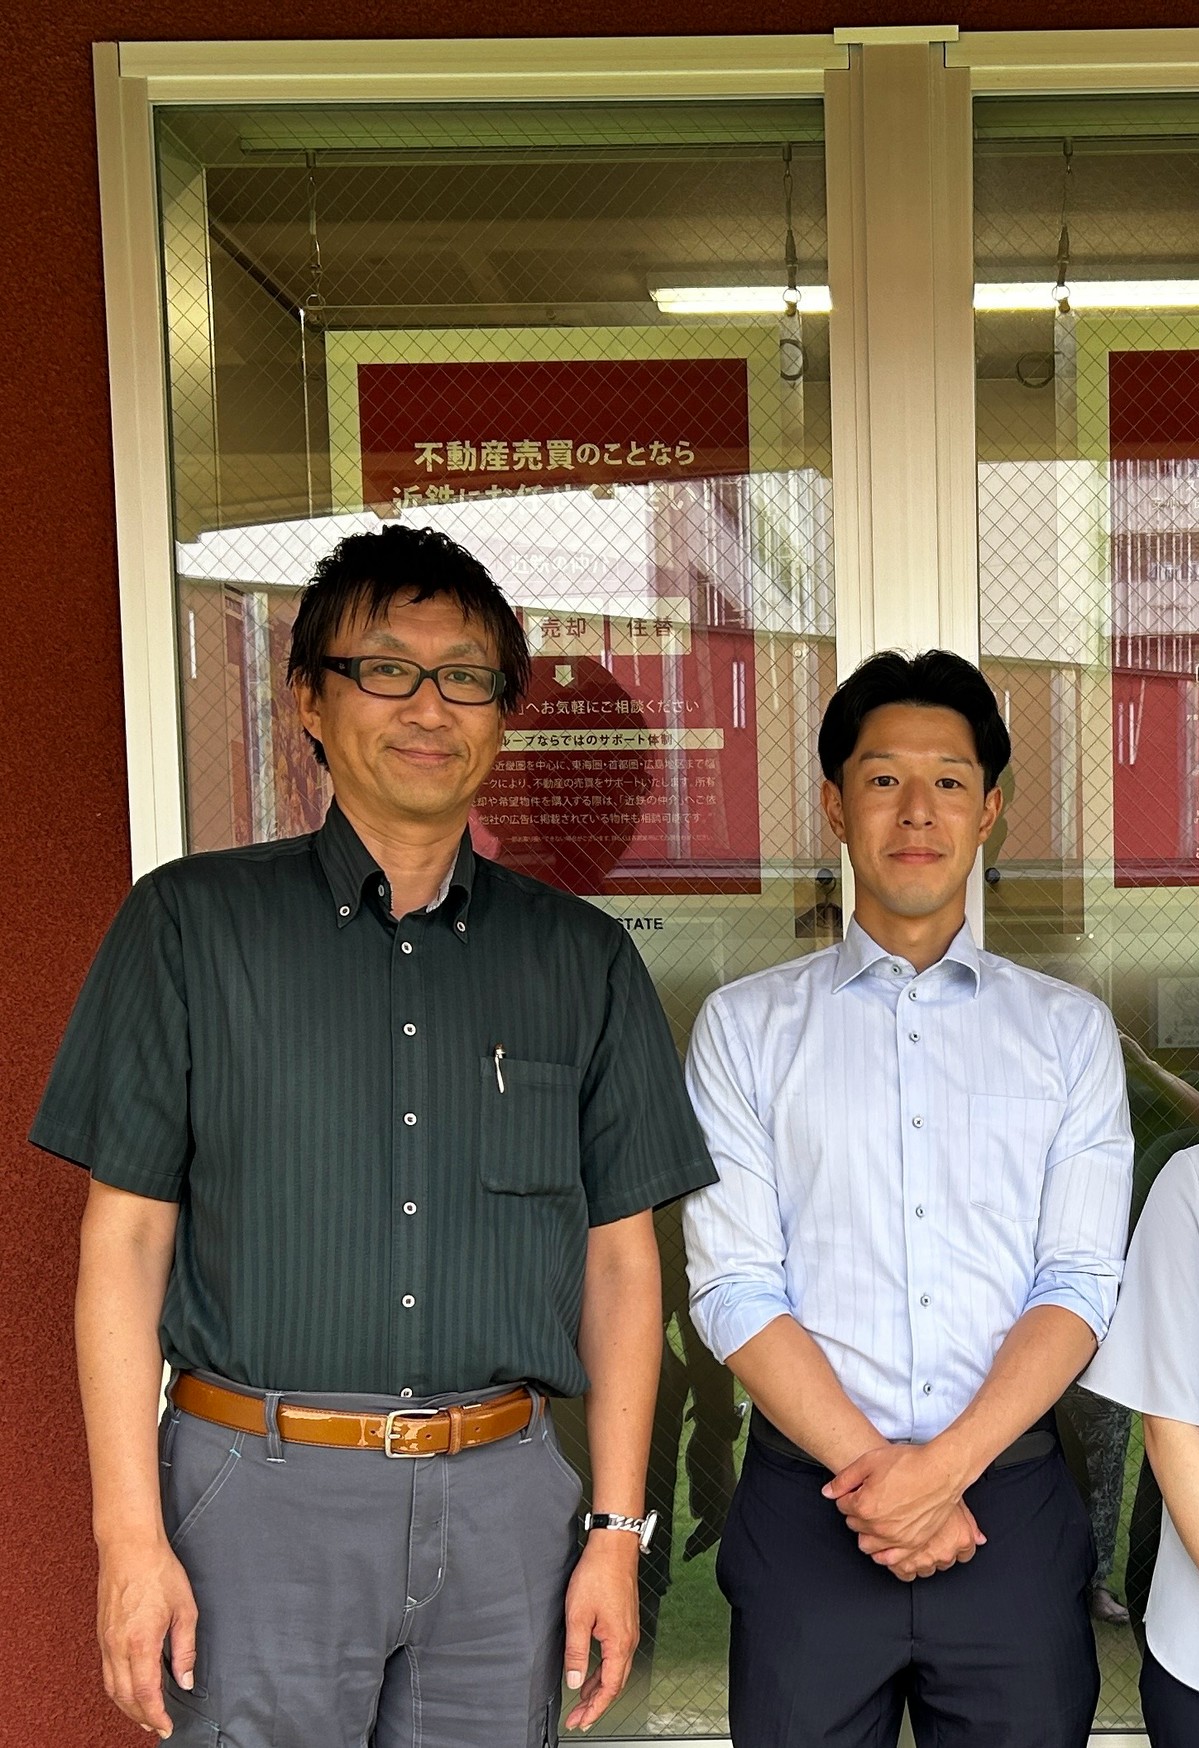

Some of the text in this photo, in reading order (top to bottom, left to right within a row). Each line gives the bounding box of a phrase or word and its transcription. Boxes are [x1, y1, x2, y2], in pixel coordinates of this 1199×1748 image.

[413, 439, 695, 473] 不動産売買のことなら
[541, 617, 587, 638] 売却
[627, 617, 674, 638] 住替
